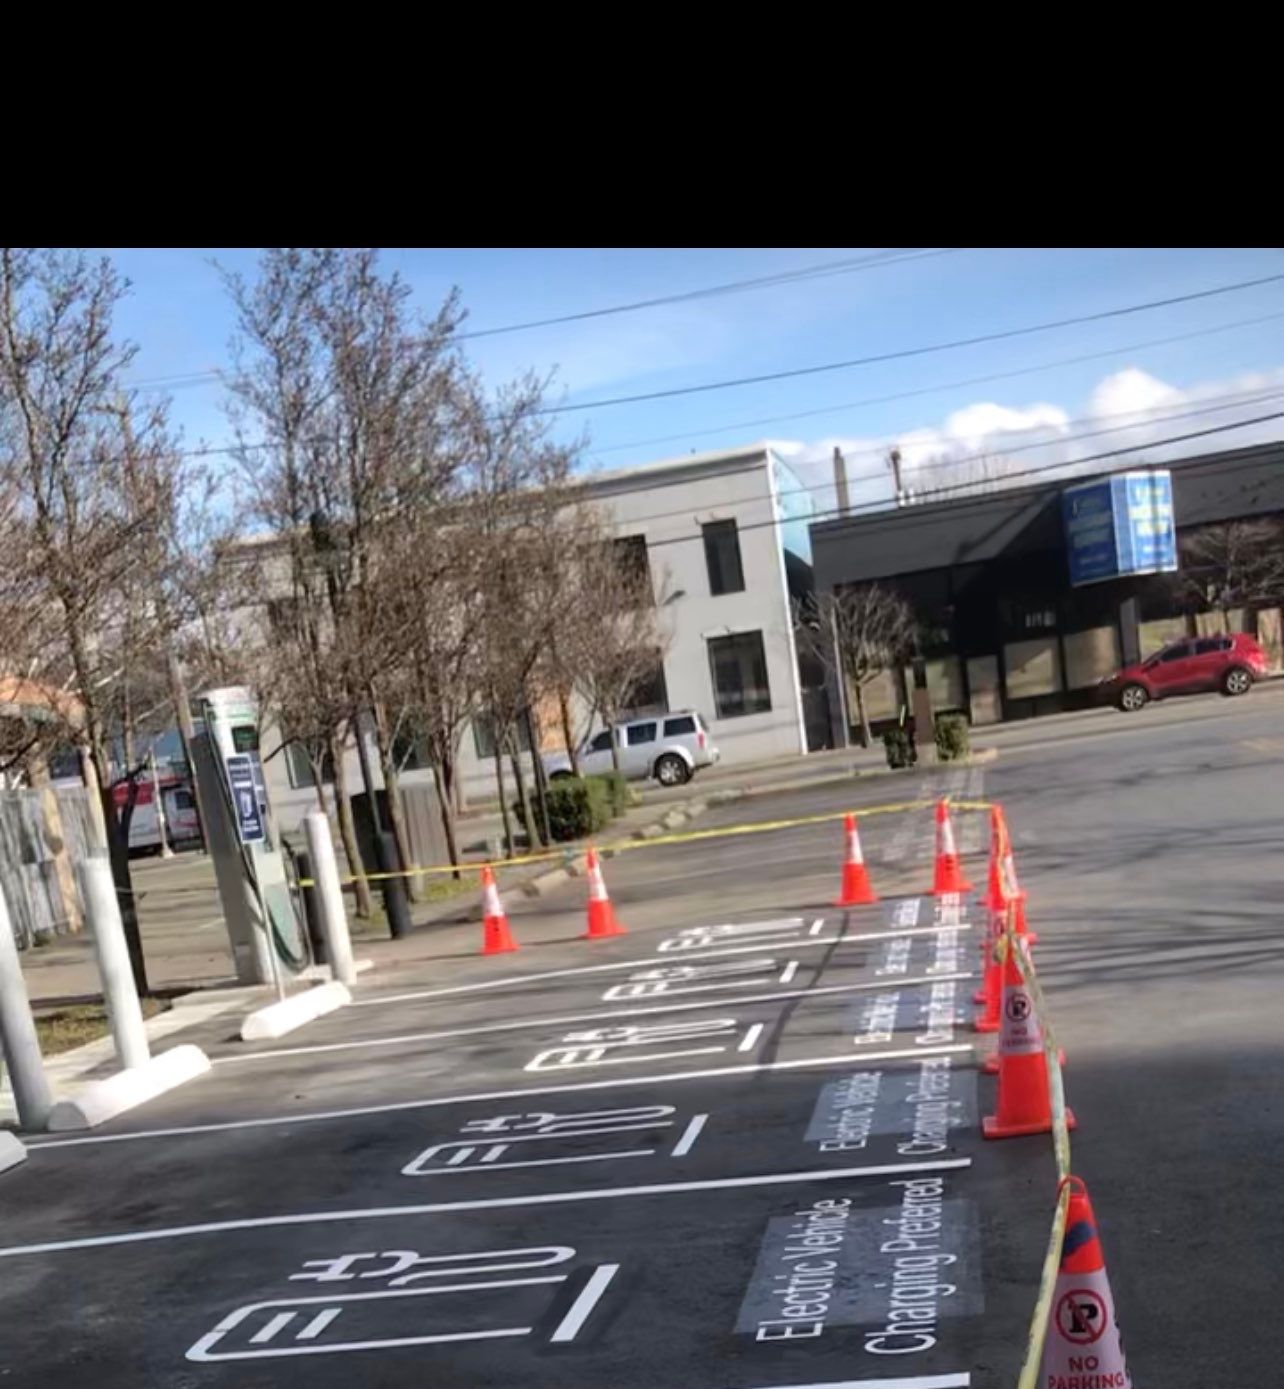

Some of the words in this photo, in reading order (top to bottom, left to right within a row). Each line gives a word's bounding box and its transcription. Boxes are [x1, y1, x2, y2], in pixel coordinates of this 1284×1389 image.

[781, 1198, 852, 1261] Vehicle
[880, 1177, 944, 1253] Preferred
[756, 1259, 838, 1342] Electric
[864, 1253, 958, 1355] Charging
[1068, 1354, 1099, 1371] NO
